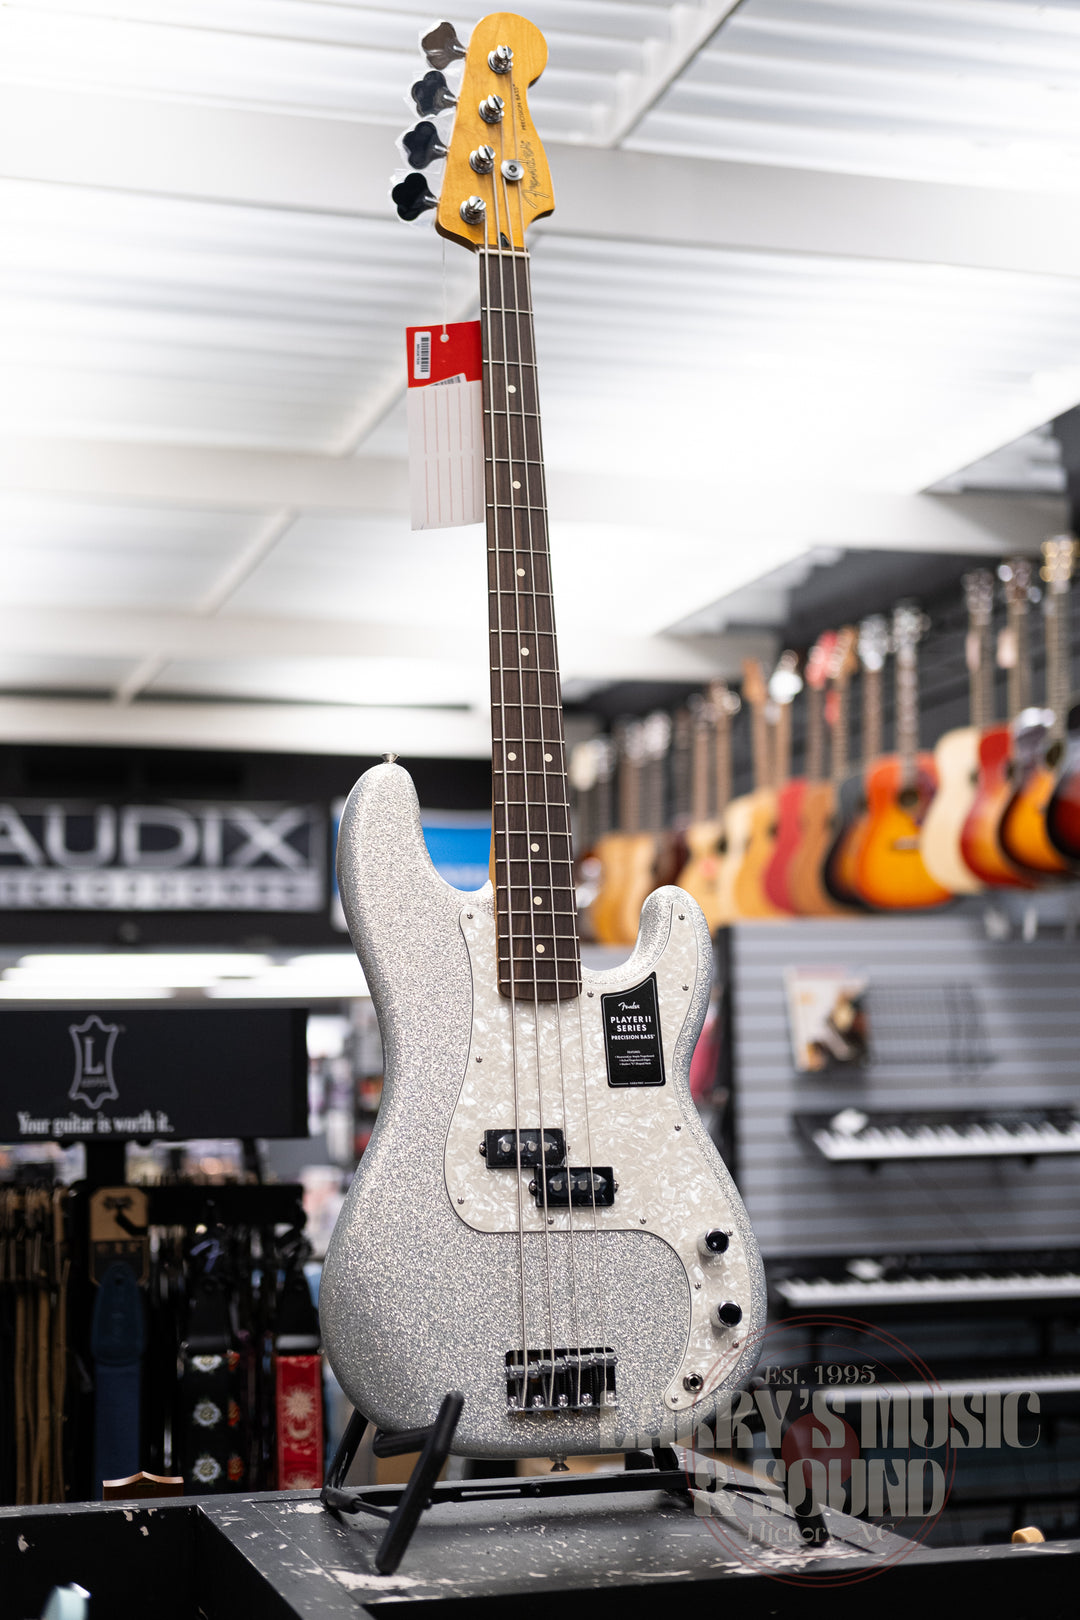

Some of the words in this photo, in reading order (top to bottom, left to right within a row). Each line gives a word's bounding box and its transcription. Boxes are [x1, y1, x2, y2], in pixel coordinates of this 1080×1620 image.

[519, 141, 550, 209] Fender
[618, 1002, 640, 1011] Fender
[610, 1016, 644, 1024] PLAYER
[616, 1024, 647, 1032] SERIES
[17, 1112, 49, 1134] Your
[52, 1112, 95, 1137] guitar
[97, 1112, 111, 1133] is
[113, 1110, 155, 1133] worth
[157, 1111, 174, 1133] it.
